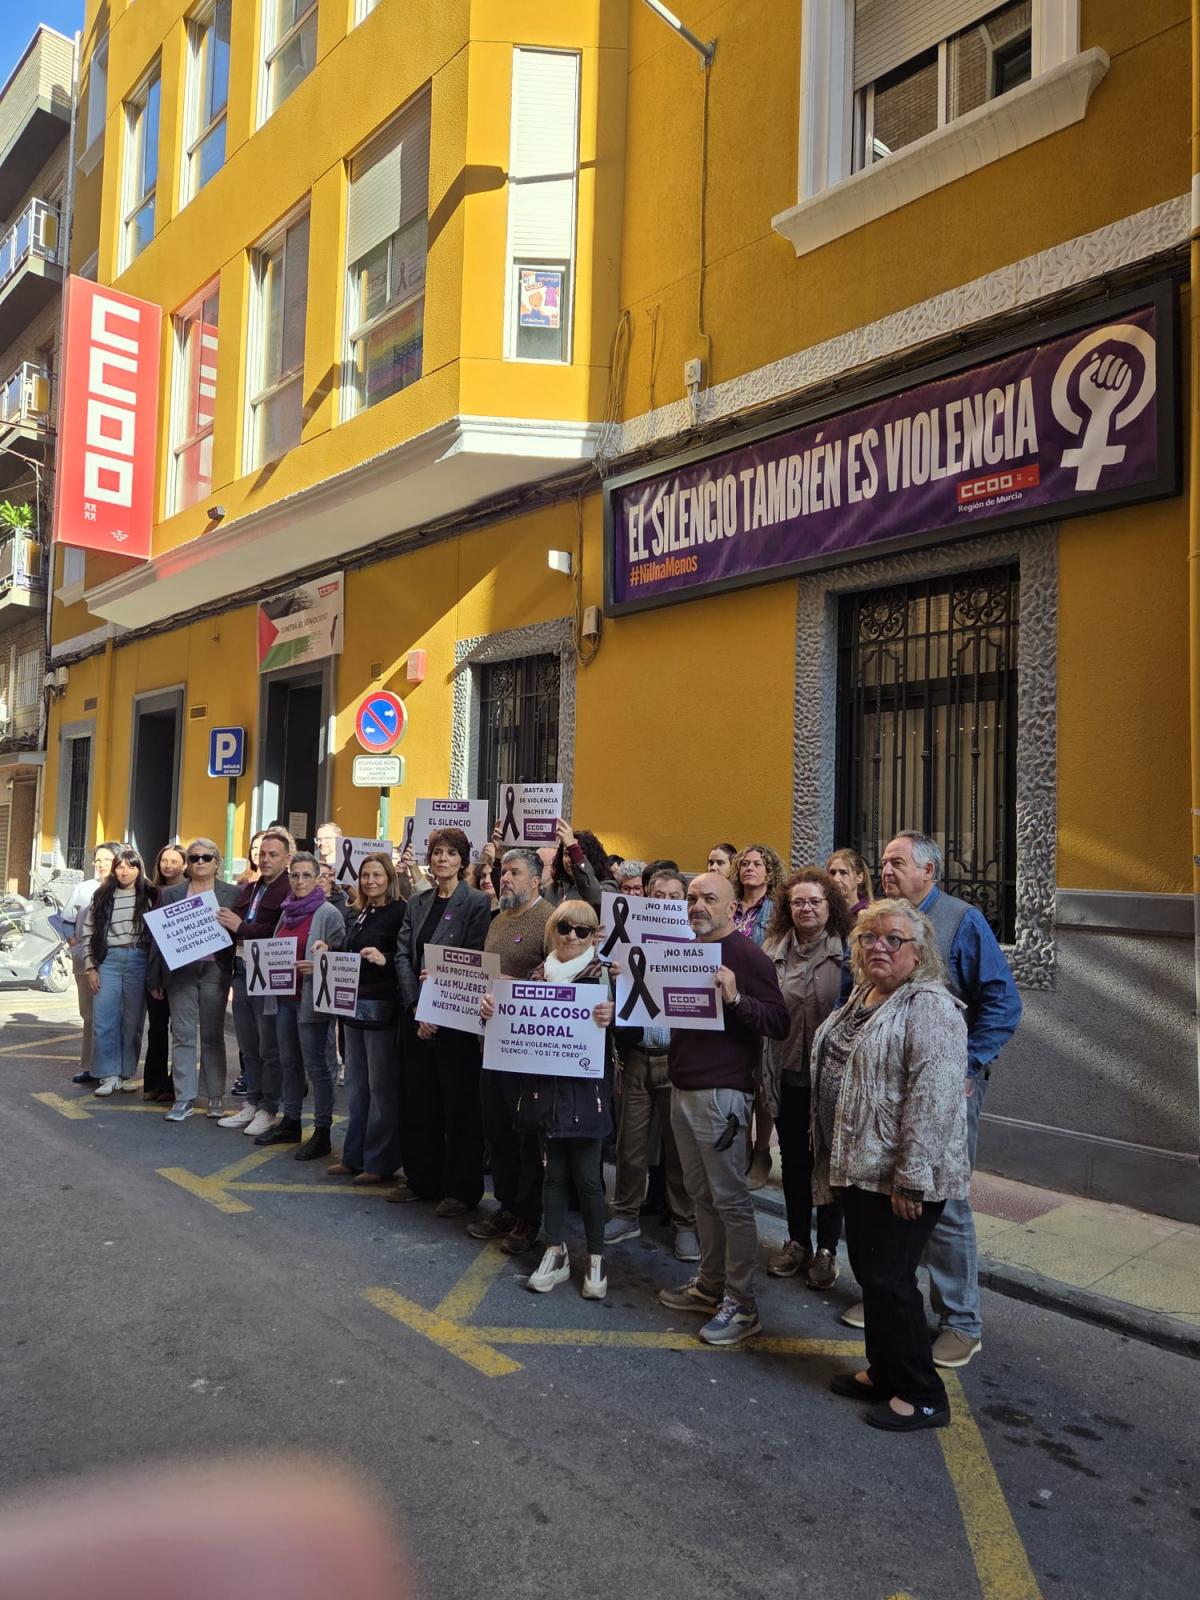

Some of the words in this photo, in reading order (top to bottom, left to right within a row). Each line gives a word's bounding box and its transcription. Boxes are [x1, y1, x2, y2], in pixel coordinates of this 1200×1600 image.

[83, 294, 140, 508] CCOO
[629, 504, 649, 562] EL
[652, 474, 736, 556] SILENCIO
[740, 433, 842, 532] TAMBIÉN
[848, 428, 879, 504] ES
[884, 376, 1039, 492] VIOLENCIA
[960, 474, 1013, 498] CCOO
[958, 500, 984, 512] Región
[985, 498, 995, 506] de
[996, 491, 1023, 504] Murcia
[630, 555, 698, 586] #NiUnaMenos
[216, 733, 237, 771] P
[434, 803, 458, 811] CCOO
[438, 818, 471, 827] SILENCIO
[165, 902, 193, 917] CCOO
[645, 902, 661, 911] ¡NO
[172, 928, 184, 937] LAS
[187, 930, 208, 940] LUCHA
[175, 939, 204, 954] NUESTRA
[664, 948, 680, 958] ¡NO
[683, 947, 704, 957] MÁS
[445, 951, 470, 963] CCOO
[440, 979, 451, 988] LAS
[452, 981, 487, 994] MUJERES
[514, 986, 556, 999] CCOO
[440, 990, 449, 998] TU
[449, 991, 469, 1002] LUCHA
[471, 996, 479, 1004] ES
[670, 996, 696, 1004] CCOO
[432, 1000, 460, 1012] NUESTRA
[498, 1004, 516, 1015] NO
[519, 1005, 536, 1017] AL
[540, 1007, 590, 1020] ACOSO
[511, 1023, 574, 1037] LABORAL
[524, 1041, 561, 1049] VIOLENCIA,
[573, 1042, 587, 1050] MÁS
